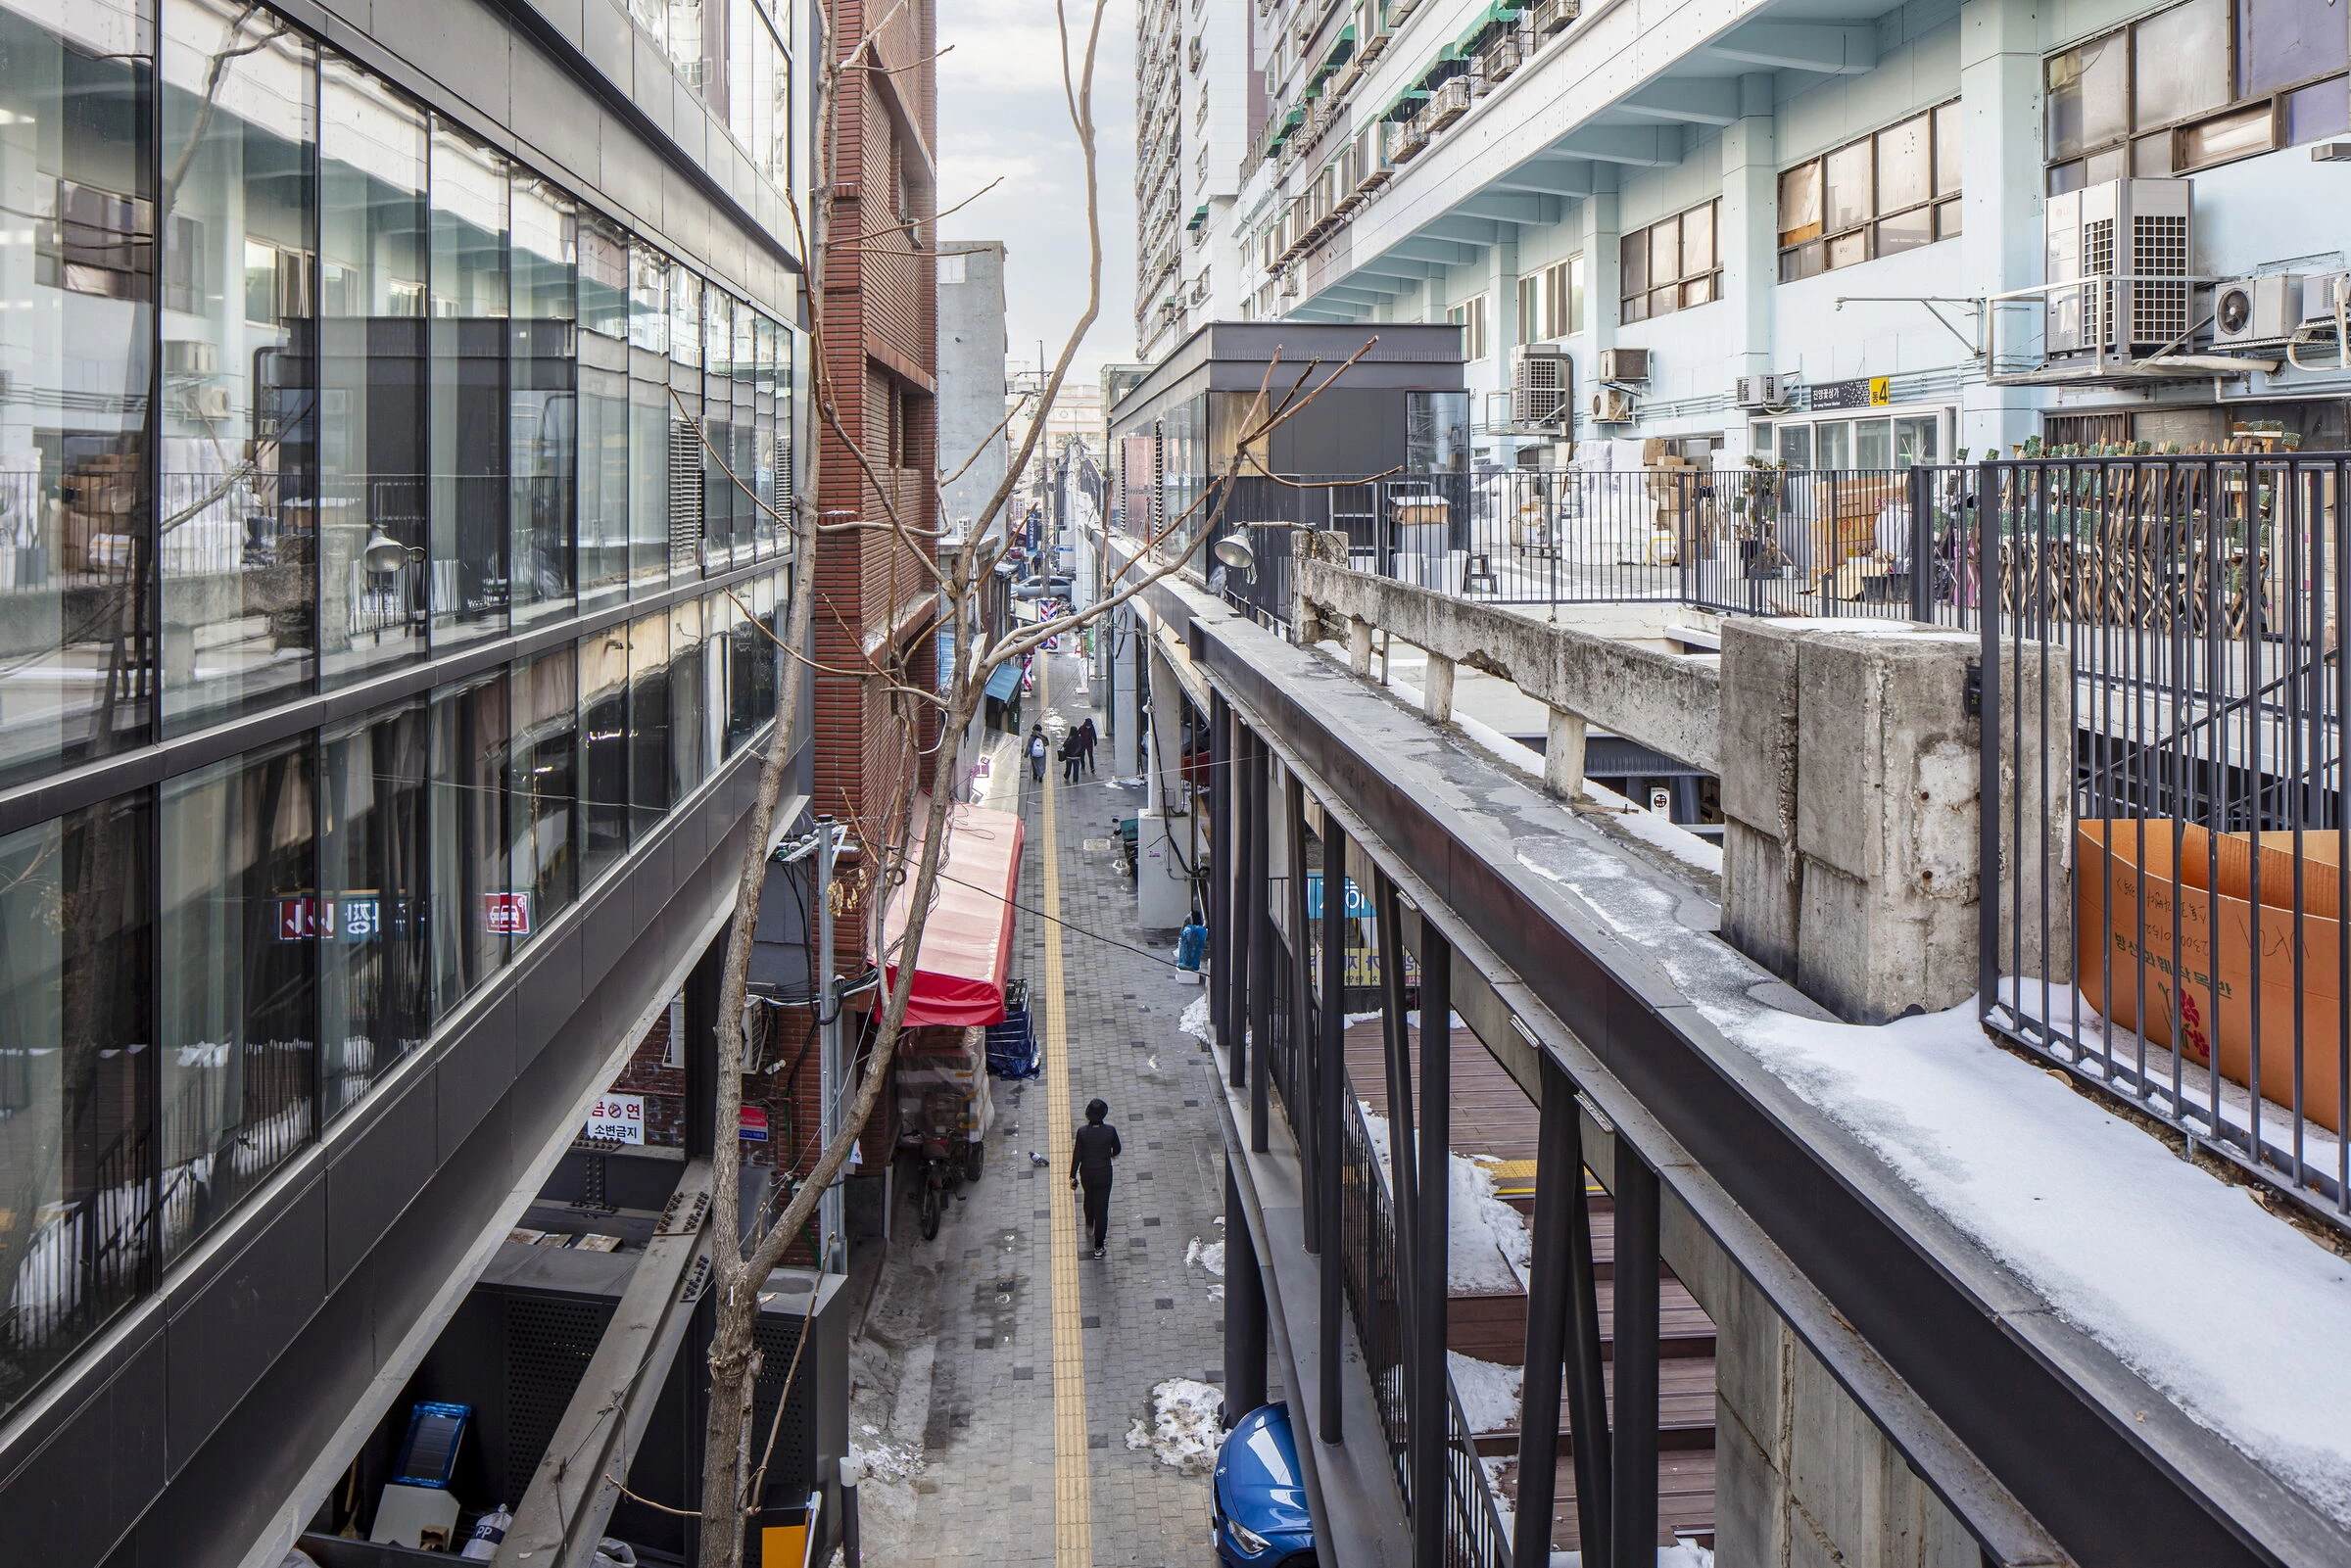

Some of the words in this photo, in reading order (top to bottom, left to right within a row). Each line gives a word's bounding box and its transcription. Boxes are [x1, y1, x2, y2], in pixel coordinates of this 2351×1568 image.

[1813, 387, 1839, 400] 진양꽃상가
[1879, 381, 1888, 403] 4
[626, 1104, 640, 1120] 연
[594, 1124, 638, 1139] 소변금지
[476, 1526, 492, 1538] PP
